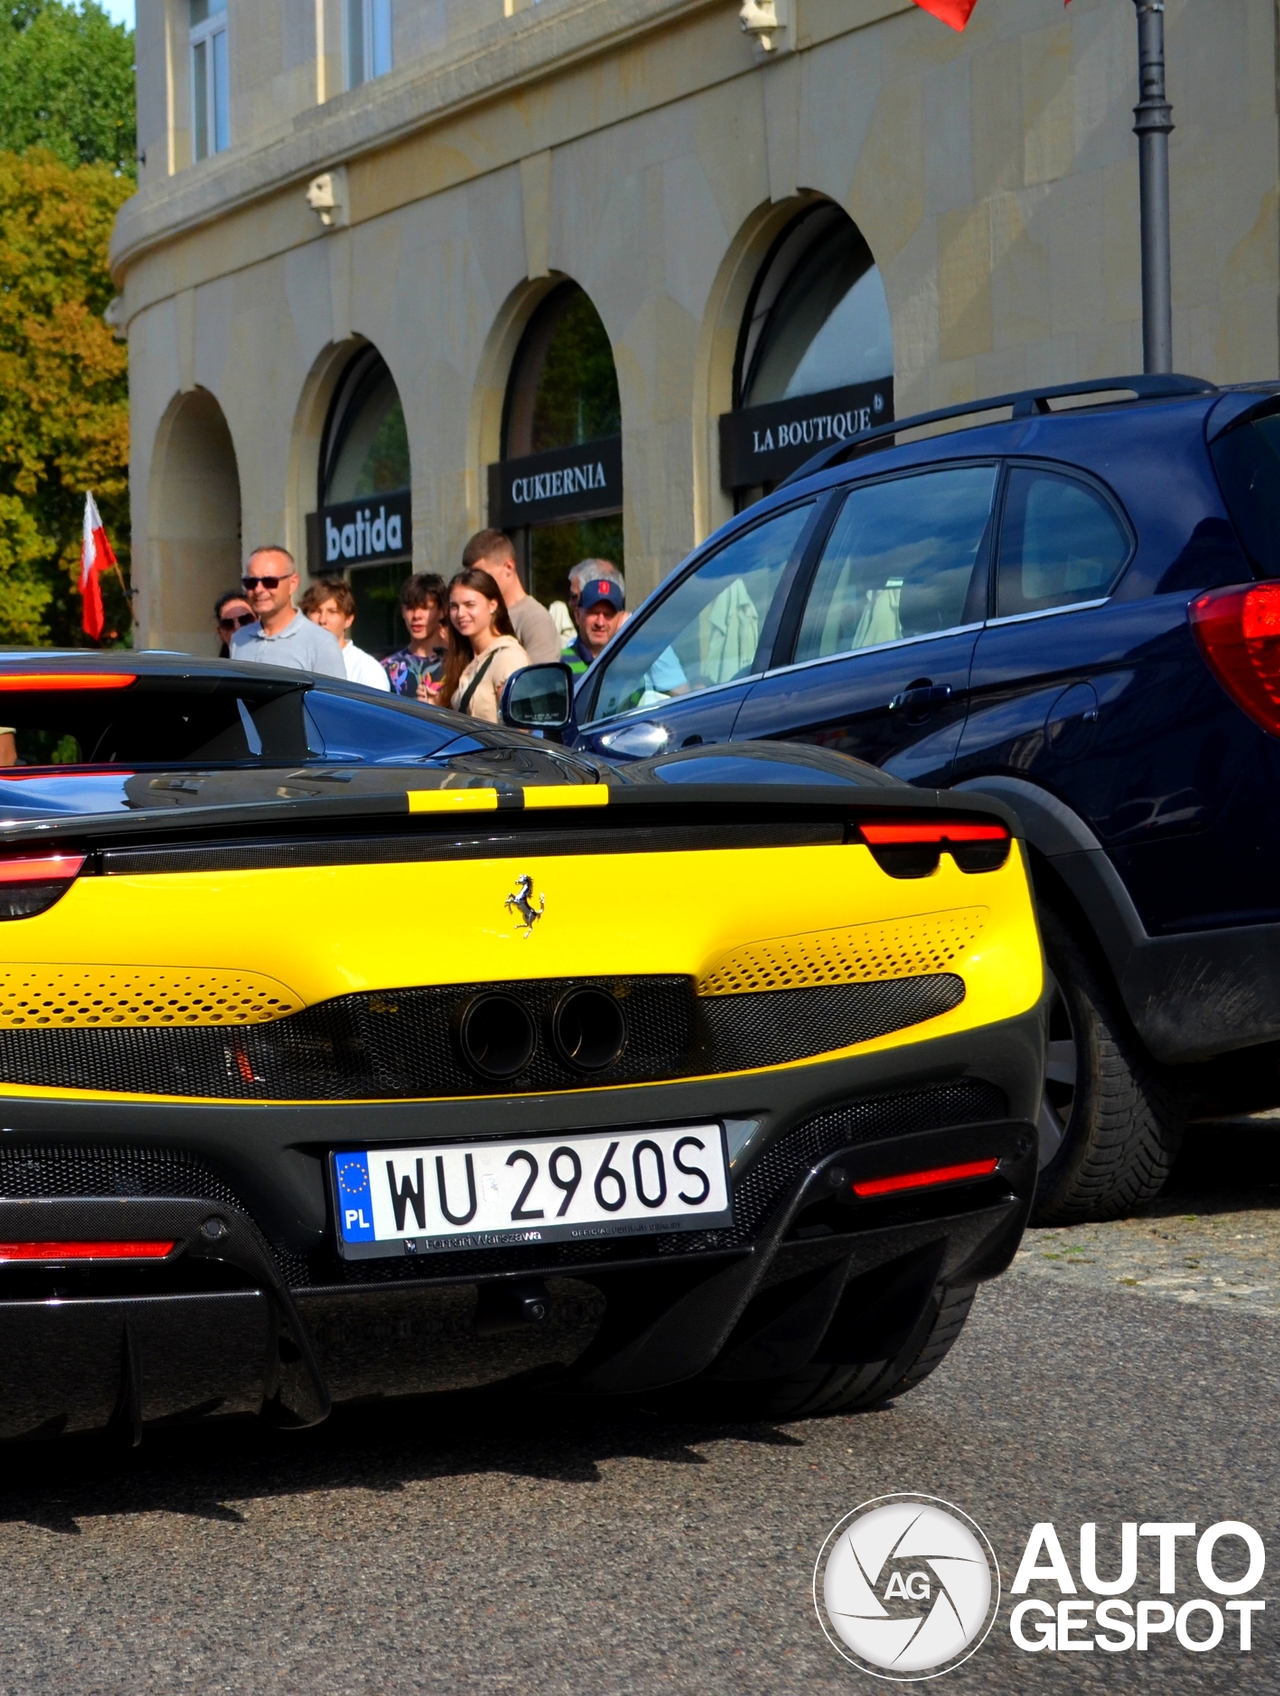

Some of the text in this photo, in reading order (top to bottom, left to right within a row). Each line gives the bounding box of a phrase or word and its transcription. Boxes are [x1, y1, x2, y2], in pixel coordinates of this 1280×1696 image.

[753, 407, 871, 453] LA BOUTIQUE
[512, 461, 606, 504] CUKIERNIA
[325, 505, 403, 561] batida
[386, 1136, 710, 1231] WU 2960S
[345, 1209, 370, 1229] PL
[424, 1231, 542, 1250] Ferrari Warszawa
[571, 1227, 609, 1237] OFFICIAL
